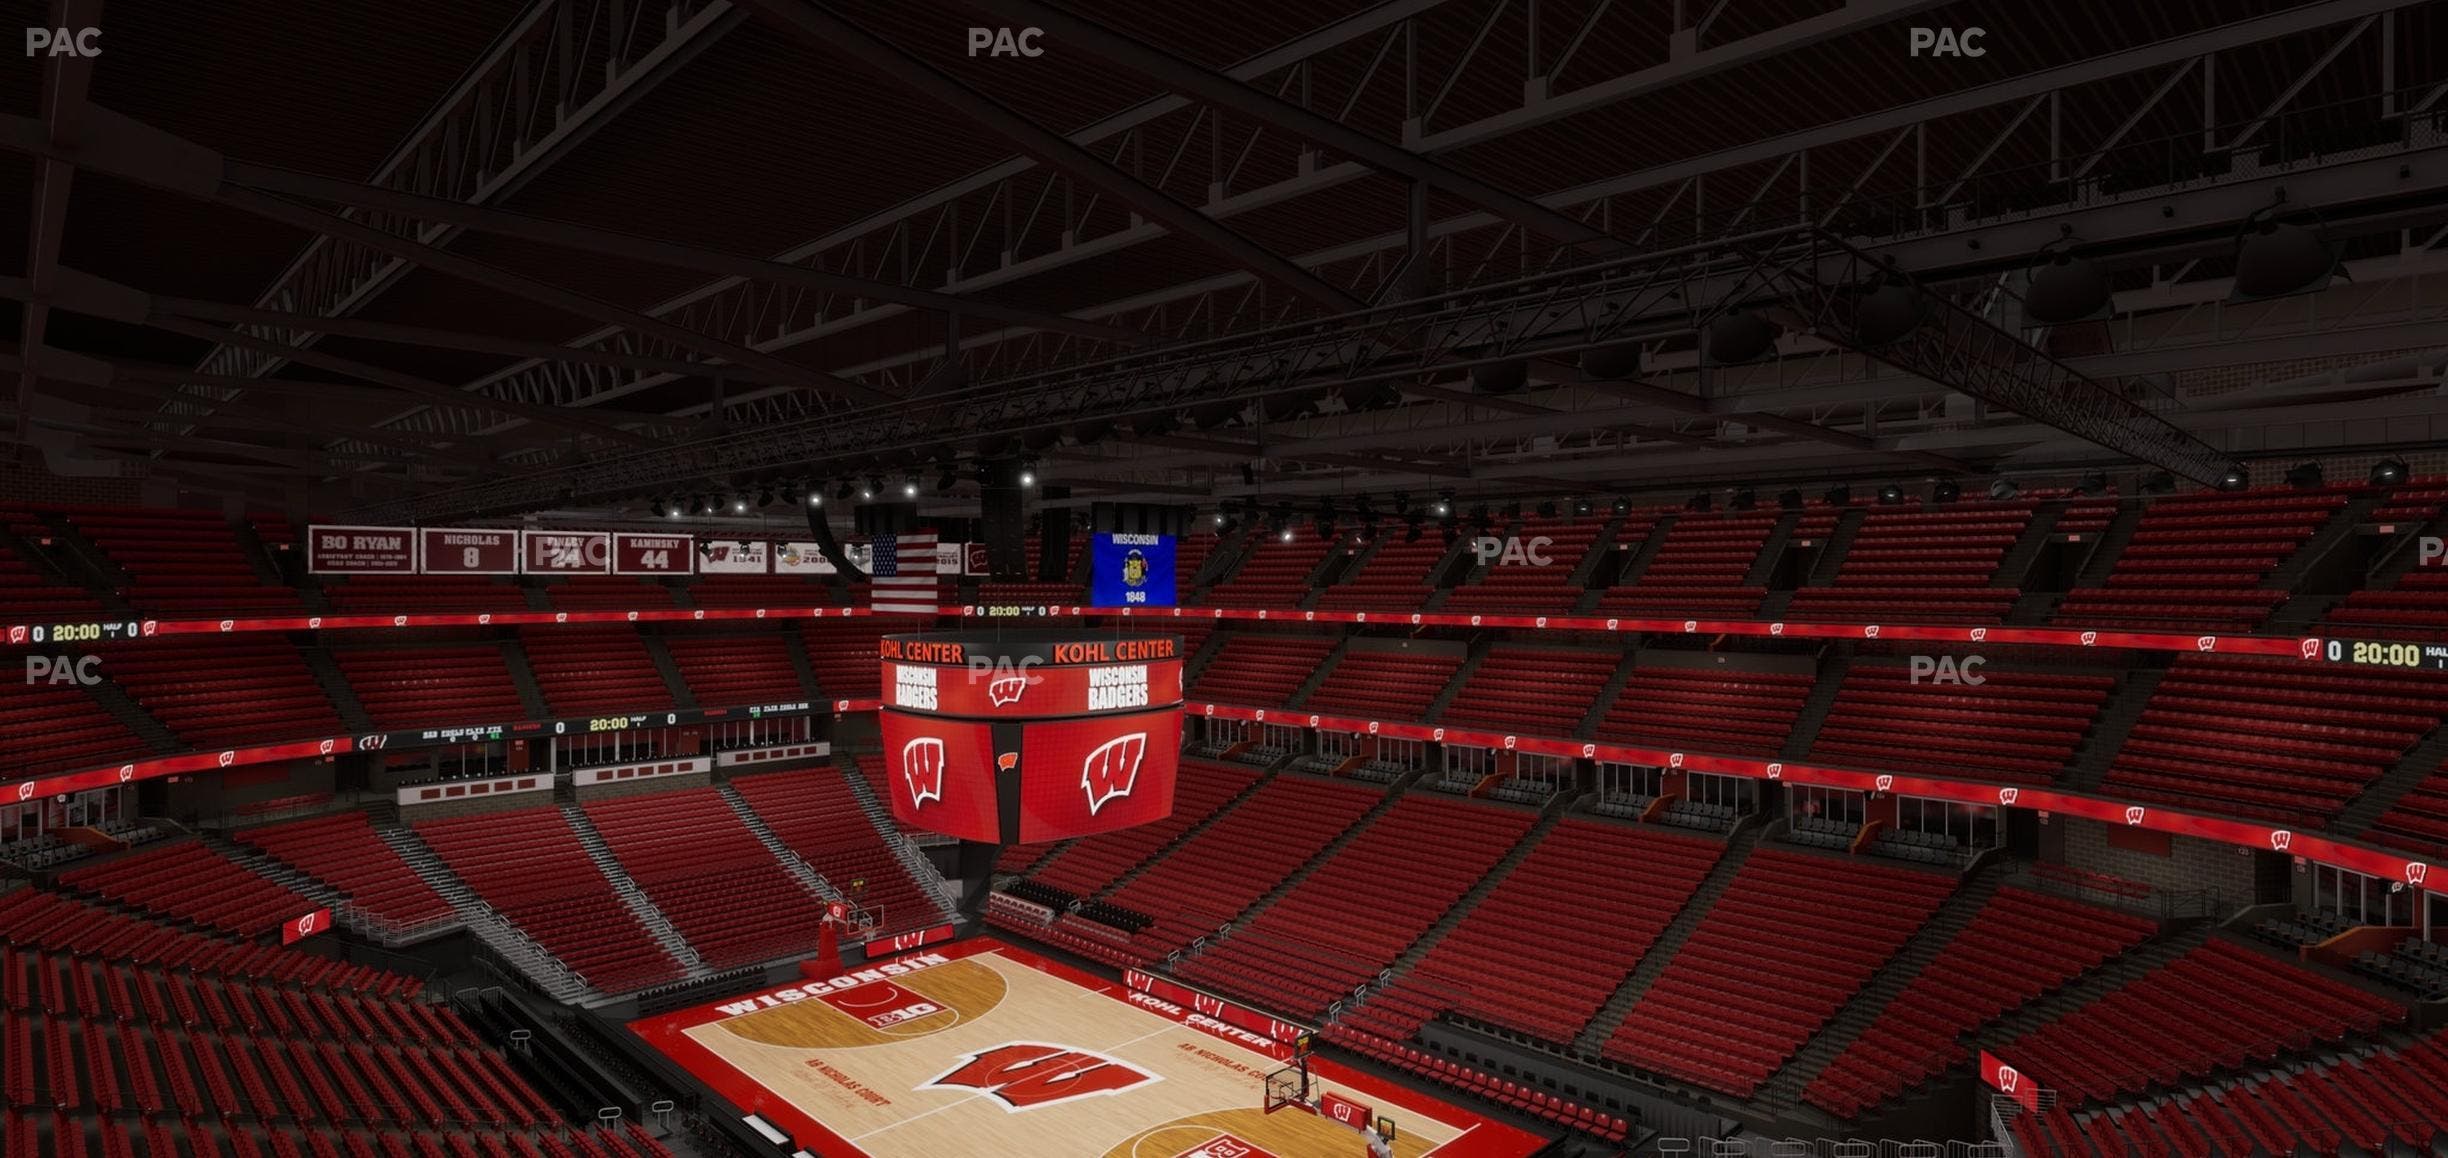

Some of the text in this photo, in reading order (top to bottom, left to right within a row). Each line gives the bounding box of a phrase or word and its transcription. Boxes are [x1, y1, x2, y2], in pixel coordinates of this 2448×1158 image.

[321, 535, 402, 550] BO RYAN
[444, 534, 500, 545] NICHOLAS
[630, 538, 680, 548] KAMINSKY
[1112, 533, 1158, 545] WISCONSIN
[463, 547, 479, 568] 8
[641, 550, 668, 568] 44
[1125, 592, 1146, 602] 1848
[977, 606, 984, 616] 0
[989, 606, 1019, 616] 20:00
[1038, 606, 1046, 616] 0
[33, 626, 44, 642] 0
[53, 624, 100, 641] 20:00
[128, 622, 138, 637] 0
[881, 642, 963, 663] KOHL CENTER
[1055, 639, 1174, 664] KOHL CENTER
[2328, 640, 2342, 661] 0
[2353, 642, 2420, 666] 20:00
[2426, 646, 2448, 657] HAL
[896, 665, 936, 687] WISCONSIN
[1089, 665, 1147, 686] WISCONSIN
[1088, 684, 1148, 711] BADGERS
[556, 722, 564, 734] 0
[590, 717, 628, 731] 20:00
[668, 713, 676, 724] 0
[903, 737, 944, 810] W
[1080, 732, 1147, 816] W
[714, 953, 950, 1016] WISCONSIN
[1129, 992, 1273, 1047] KOHL CENTER
